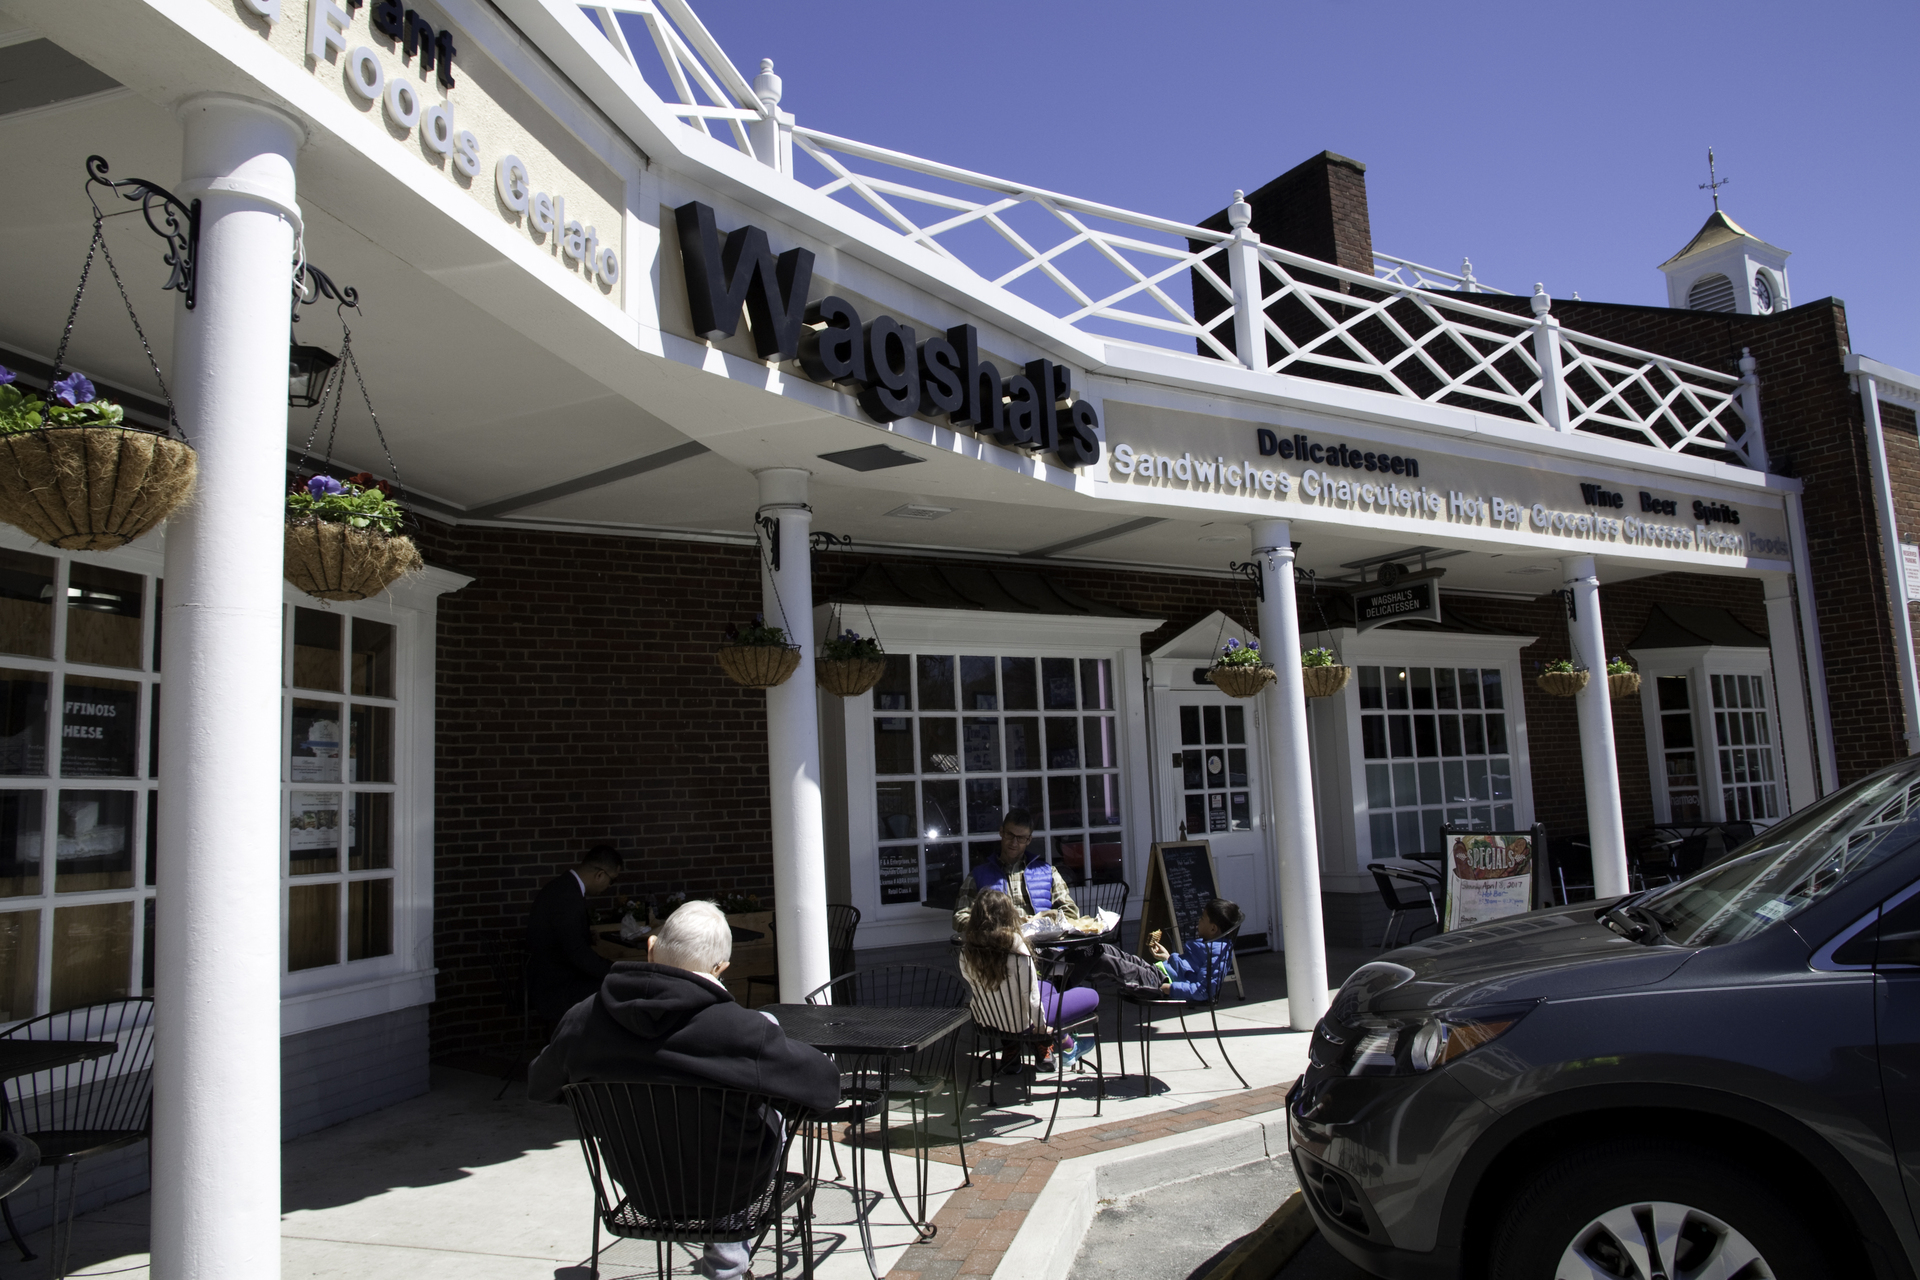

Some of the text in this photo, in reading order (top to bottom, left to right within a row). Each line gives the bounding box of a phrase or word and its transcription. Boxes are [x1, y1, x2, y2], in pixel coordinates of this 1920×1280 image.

[347, 0, 457, 90] ant
[305, 0, 619, 286] Foods Gelato
[676, 200, 1101, 469] Wagshal's
[1256, 428, 1420, 478] Delicatessen
[1113, 443, 1789, 556] Sandwiches Charcuterie Hot Bar Groceries Cheeses Frozen Foods
[1580, 482, 1741, 526] Wine Beer Spirits
[1365, 599, 1421, 618] DELICATESSEN
[1370, 589, 1413, 607] WAGSHAL'S
[62, 725, 104, 740] HEESE
[1466, 847, 1516, 870] SPECIALS
[1507, 881, 1523, 889] 2017
